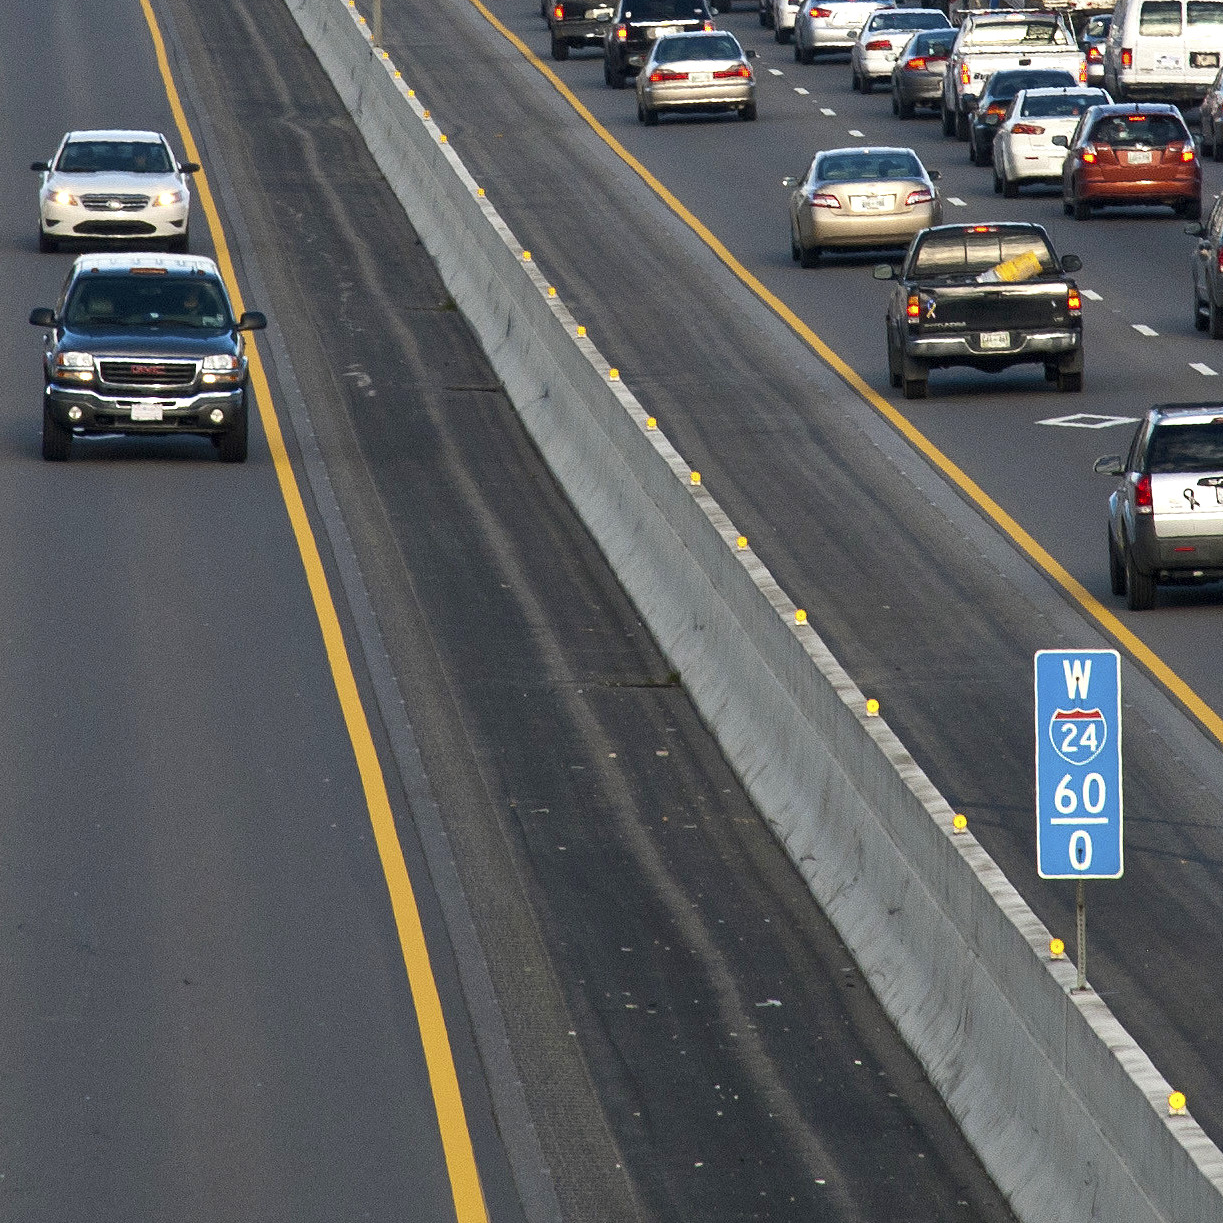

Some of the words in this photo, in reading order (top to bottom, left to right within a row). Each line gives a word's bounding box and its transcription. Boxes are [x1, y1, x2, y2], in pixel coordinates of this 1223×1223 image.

[1063, 659, 1092, 700] W
[1061, 723, 1098, 753] 24
[1054, 773, 1106, 815] 60
[1068, 830, 1093, 871] 0
